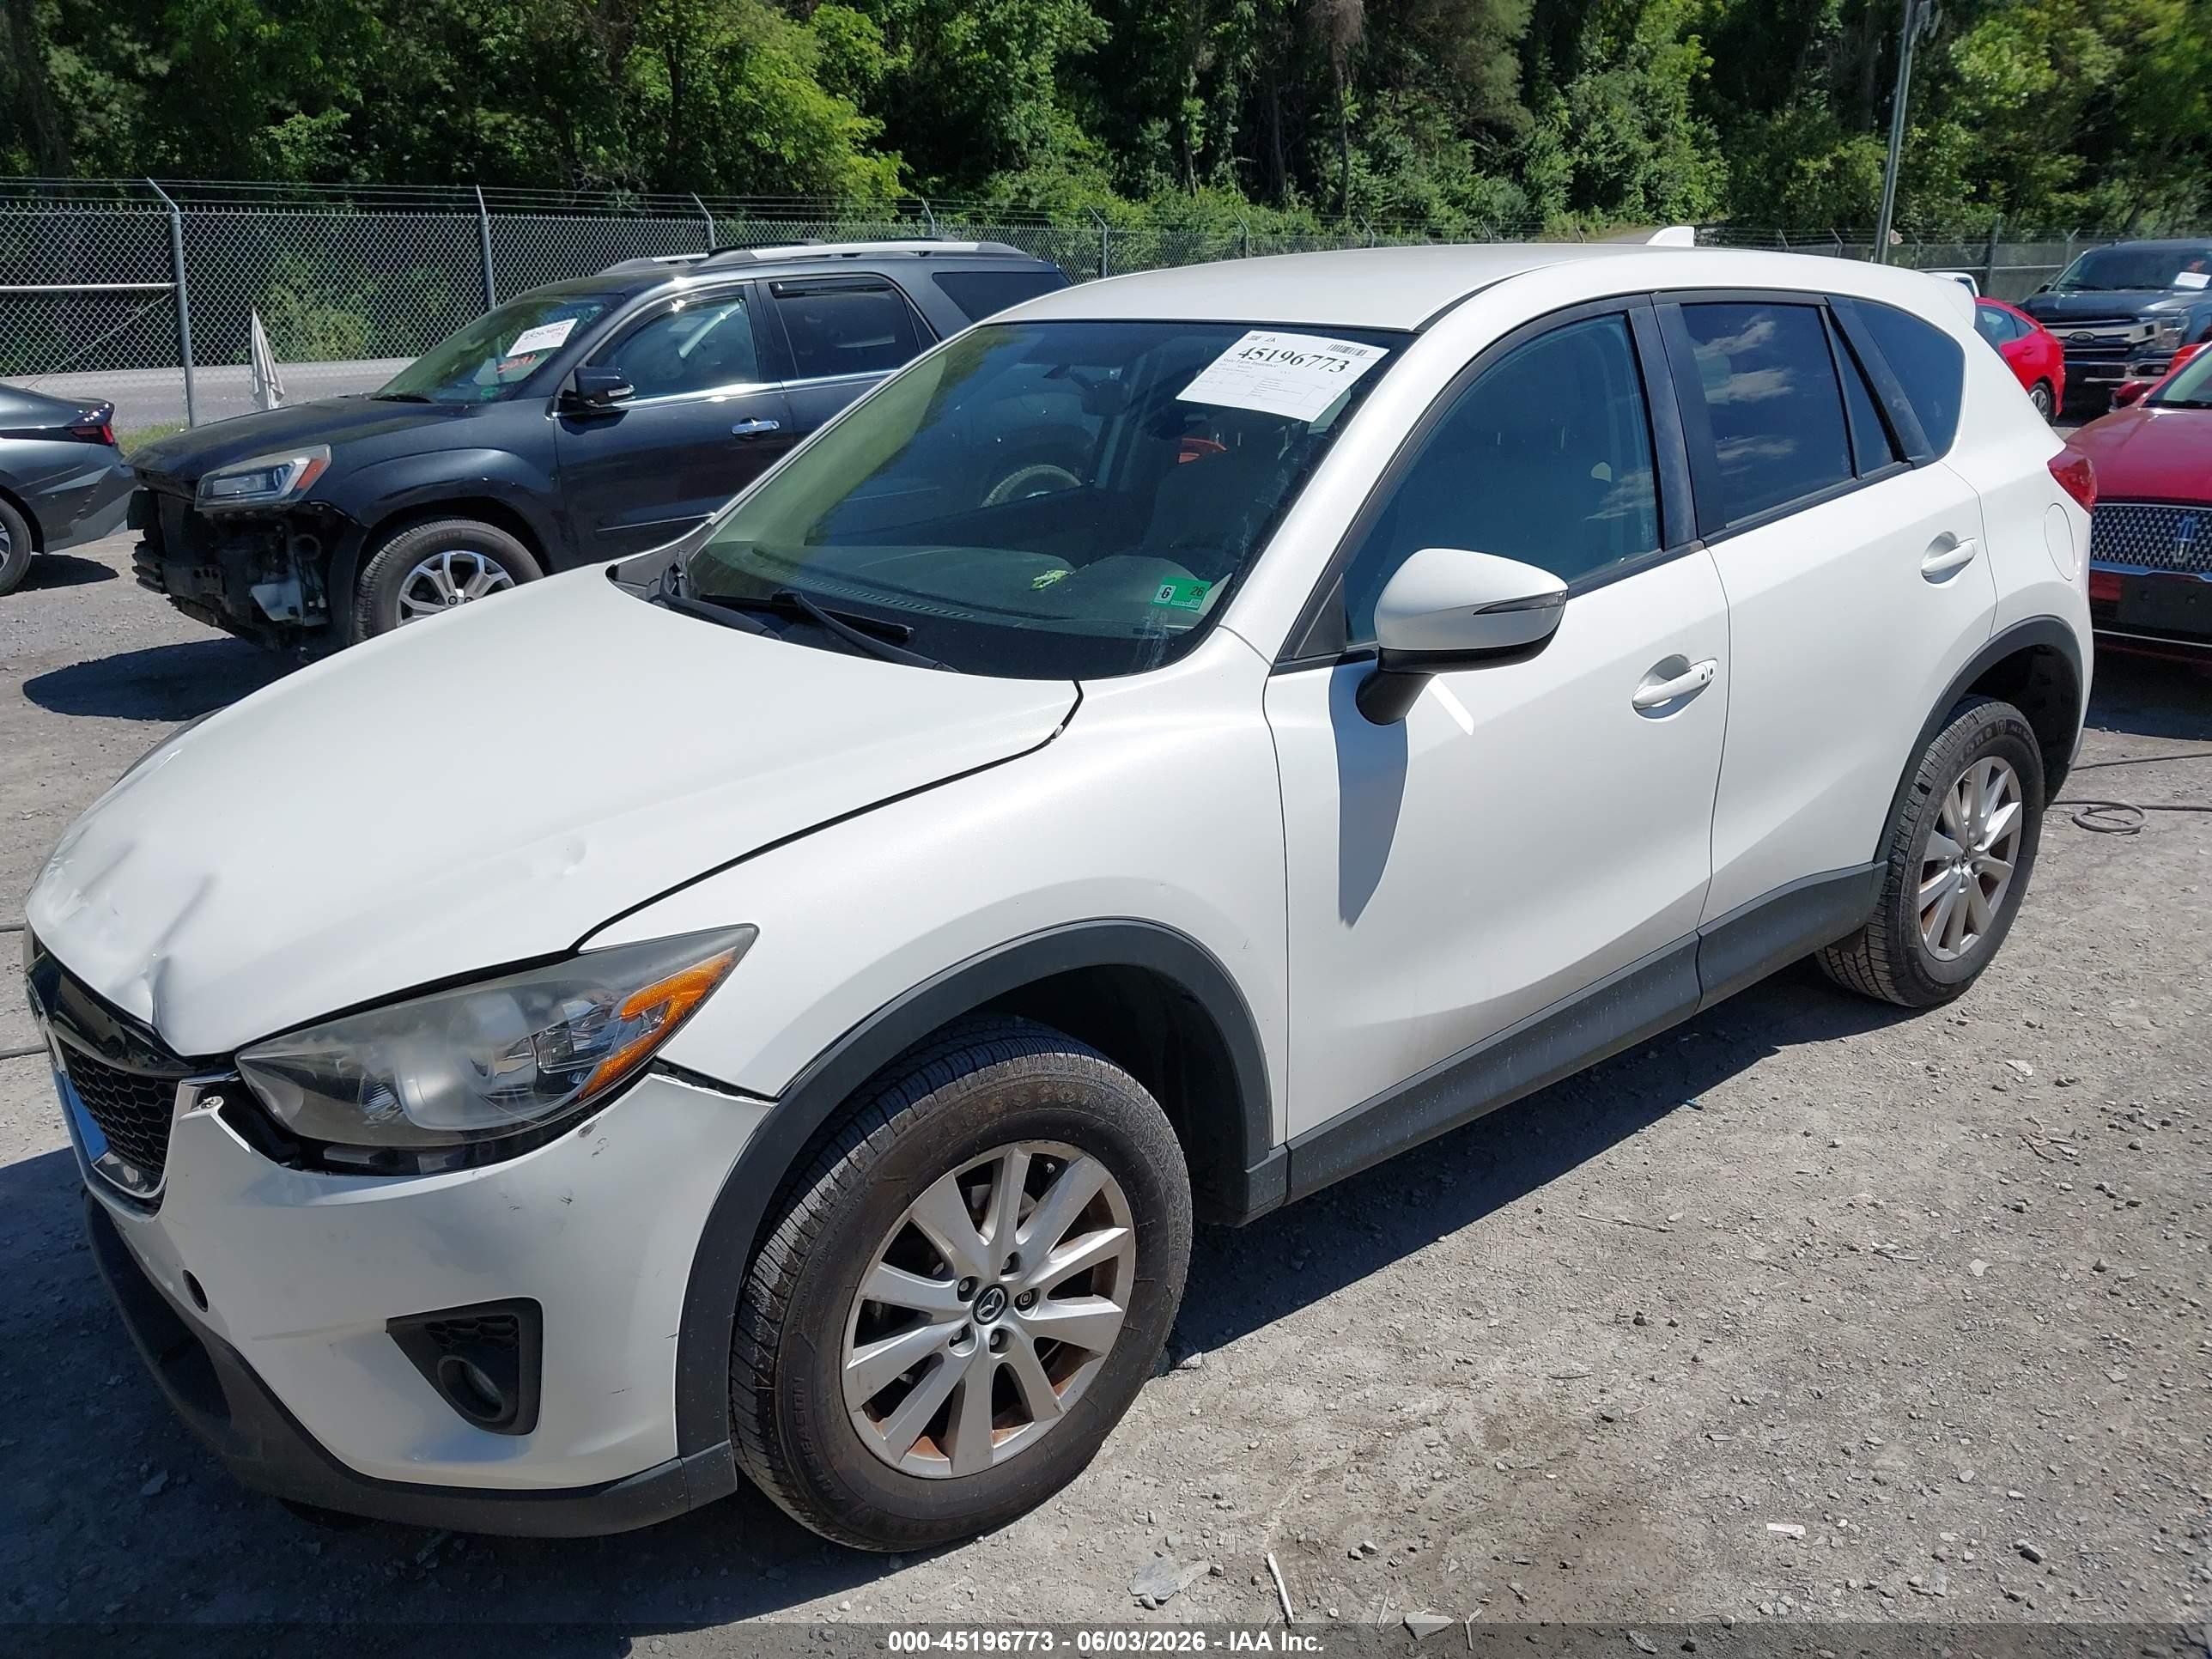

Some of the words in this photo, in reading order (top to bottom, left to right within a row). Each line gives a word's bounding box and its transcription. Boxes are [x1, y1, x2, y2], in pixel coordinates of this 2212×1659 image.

[1237, 346, 1351, 374] 45196773
[1161, 586, 1171, 599] 6
[1190, 586, 1205, 597] 26
